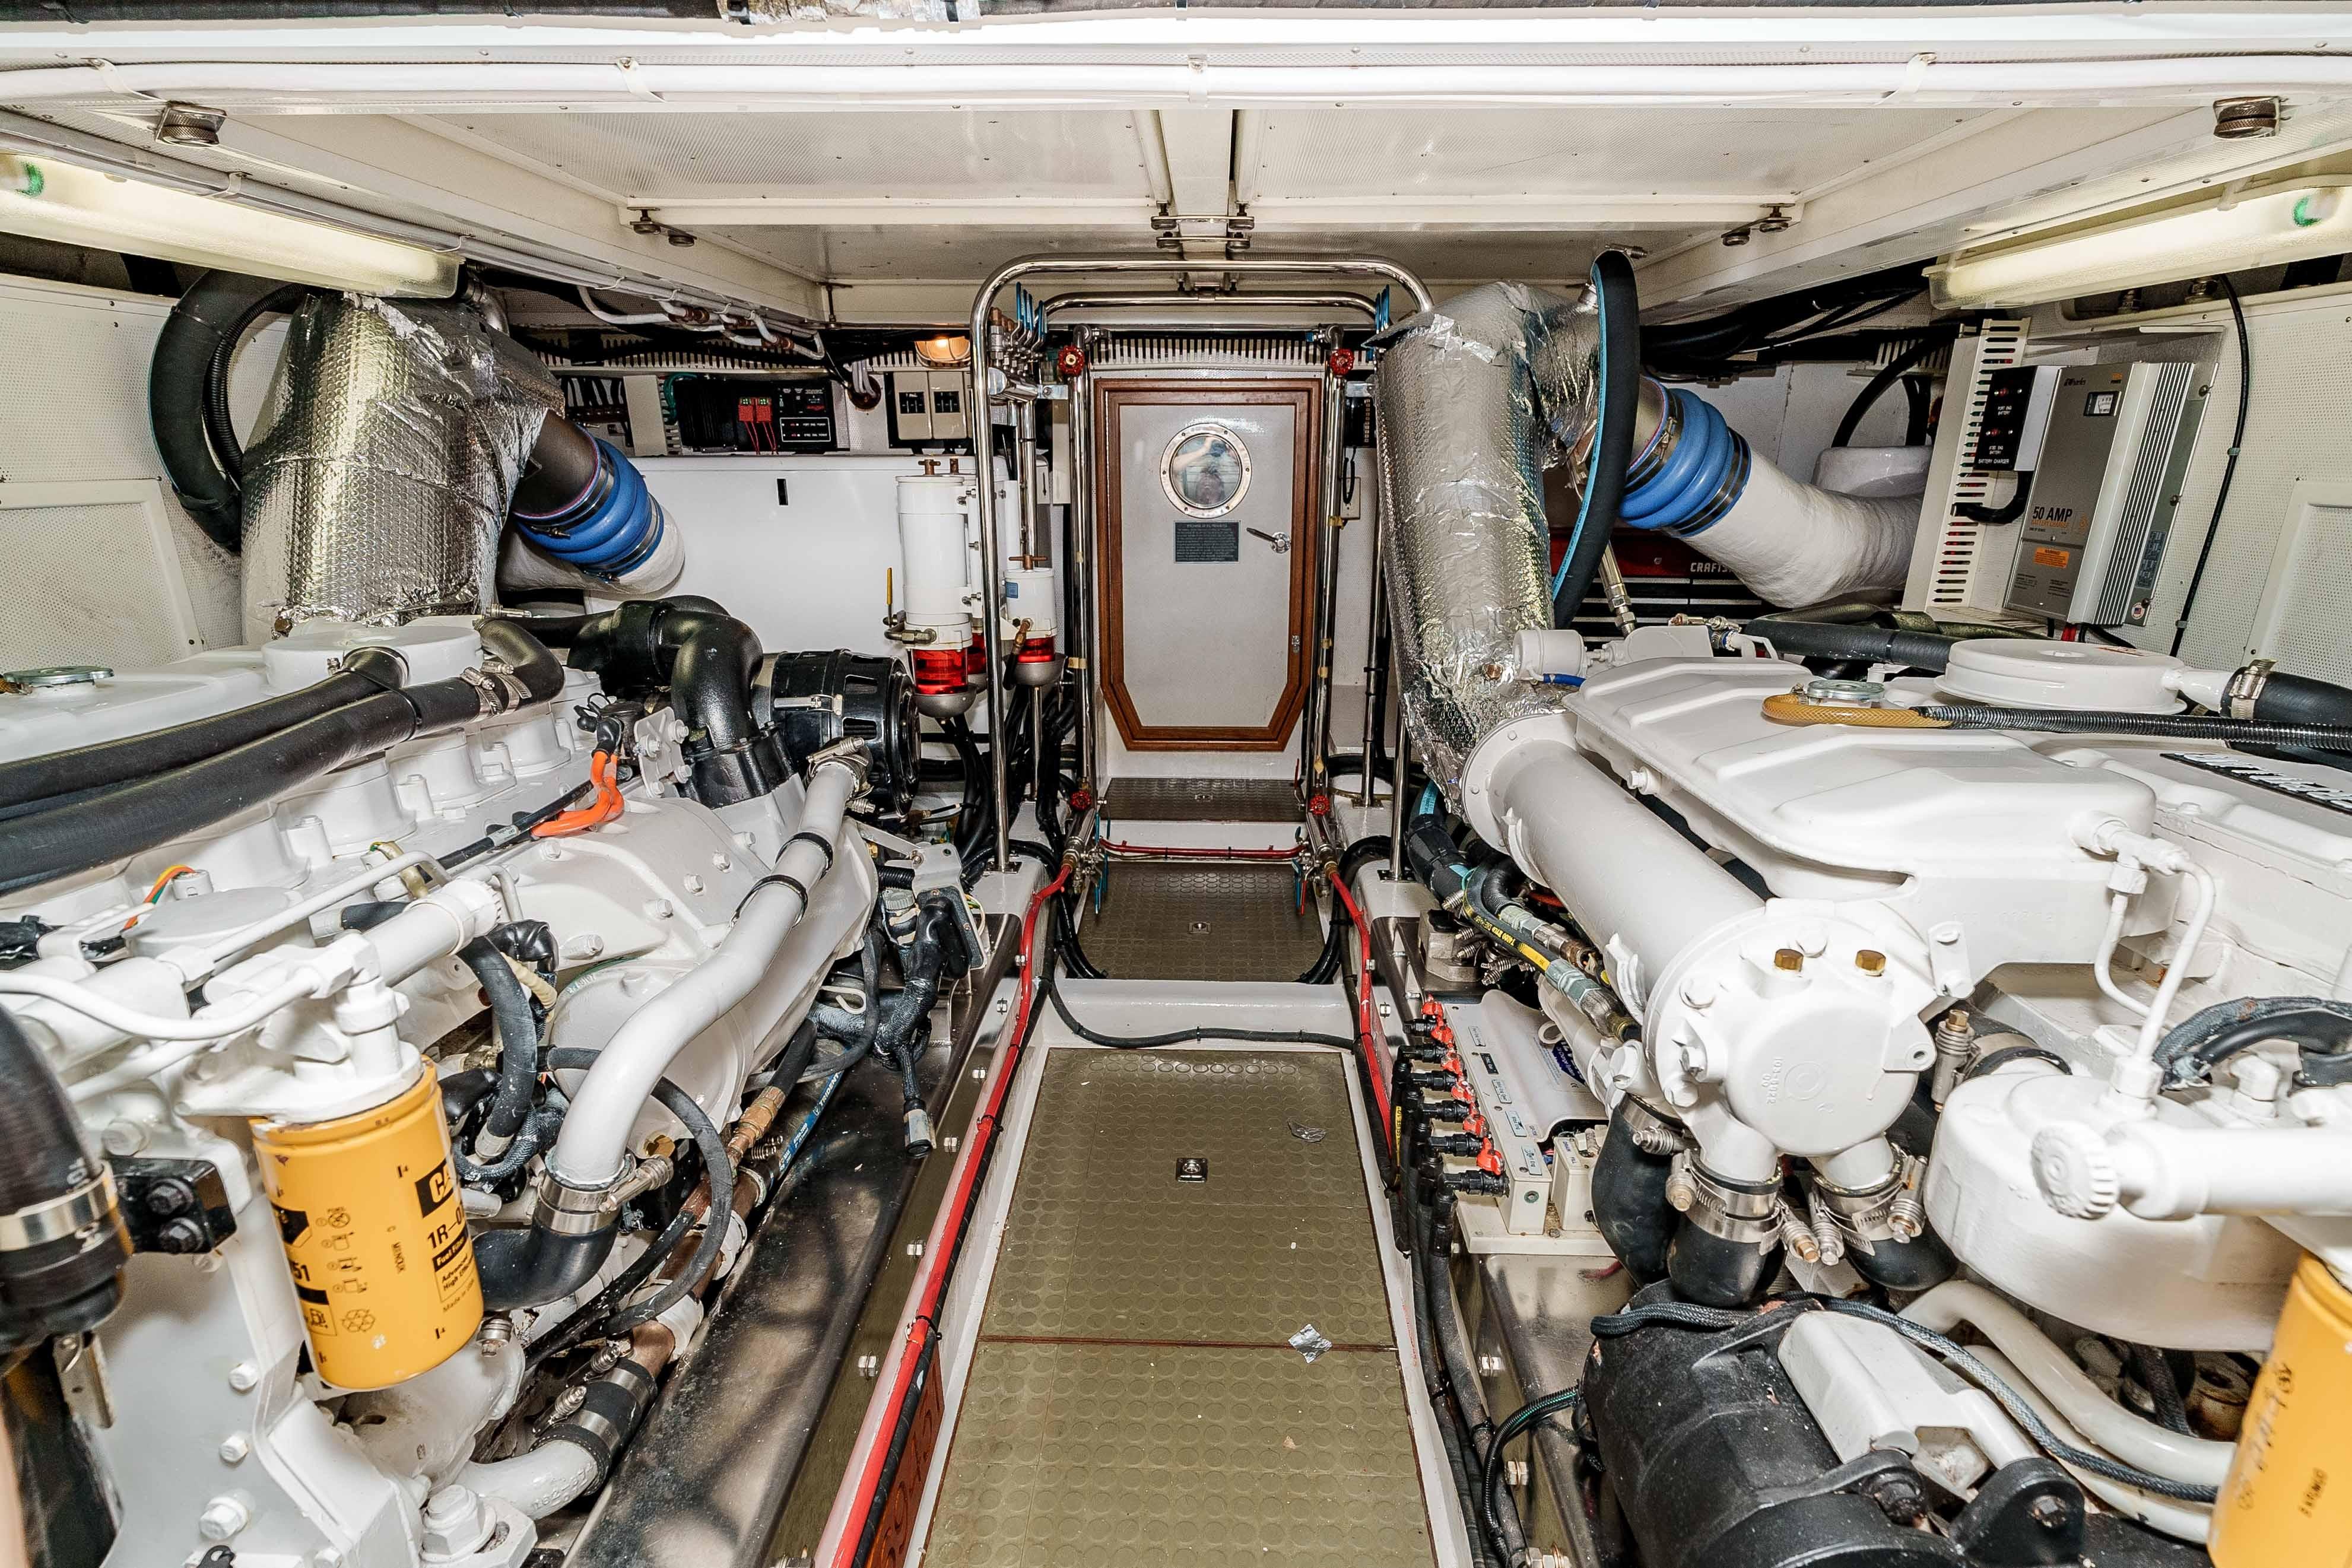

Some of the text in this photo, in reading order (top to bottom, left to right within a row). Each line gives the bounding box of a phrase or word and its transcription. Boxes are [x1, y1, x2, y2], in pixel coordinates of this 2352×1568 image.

[2032, 506, 2073, 522] 50 AMP
[1690, 562, 1733, 573] CRAFTS
[1558, 1051, 1569, 1065] Change
[819, 1072, 840, 1106] TRIDENT
[427, 1207, 465, 1249] 1R-0
[436, 1249, 453, 1266] Fuel
[443, 1276, 458, 1291] High
